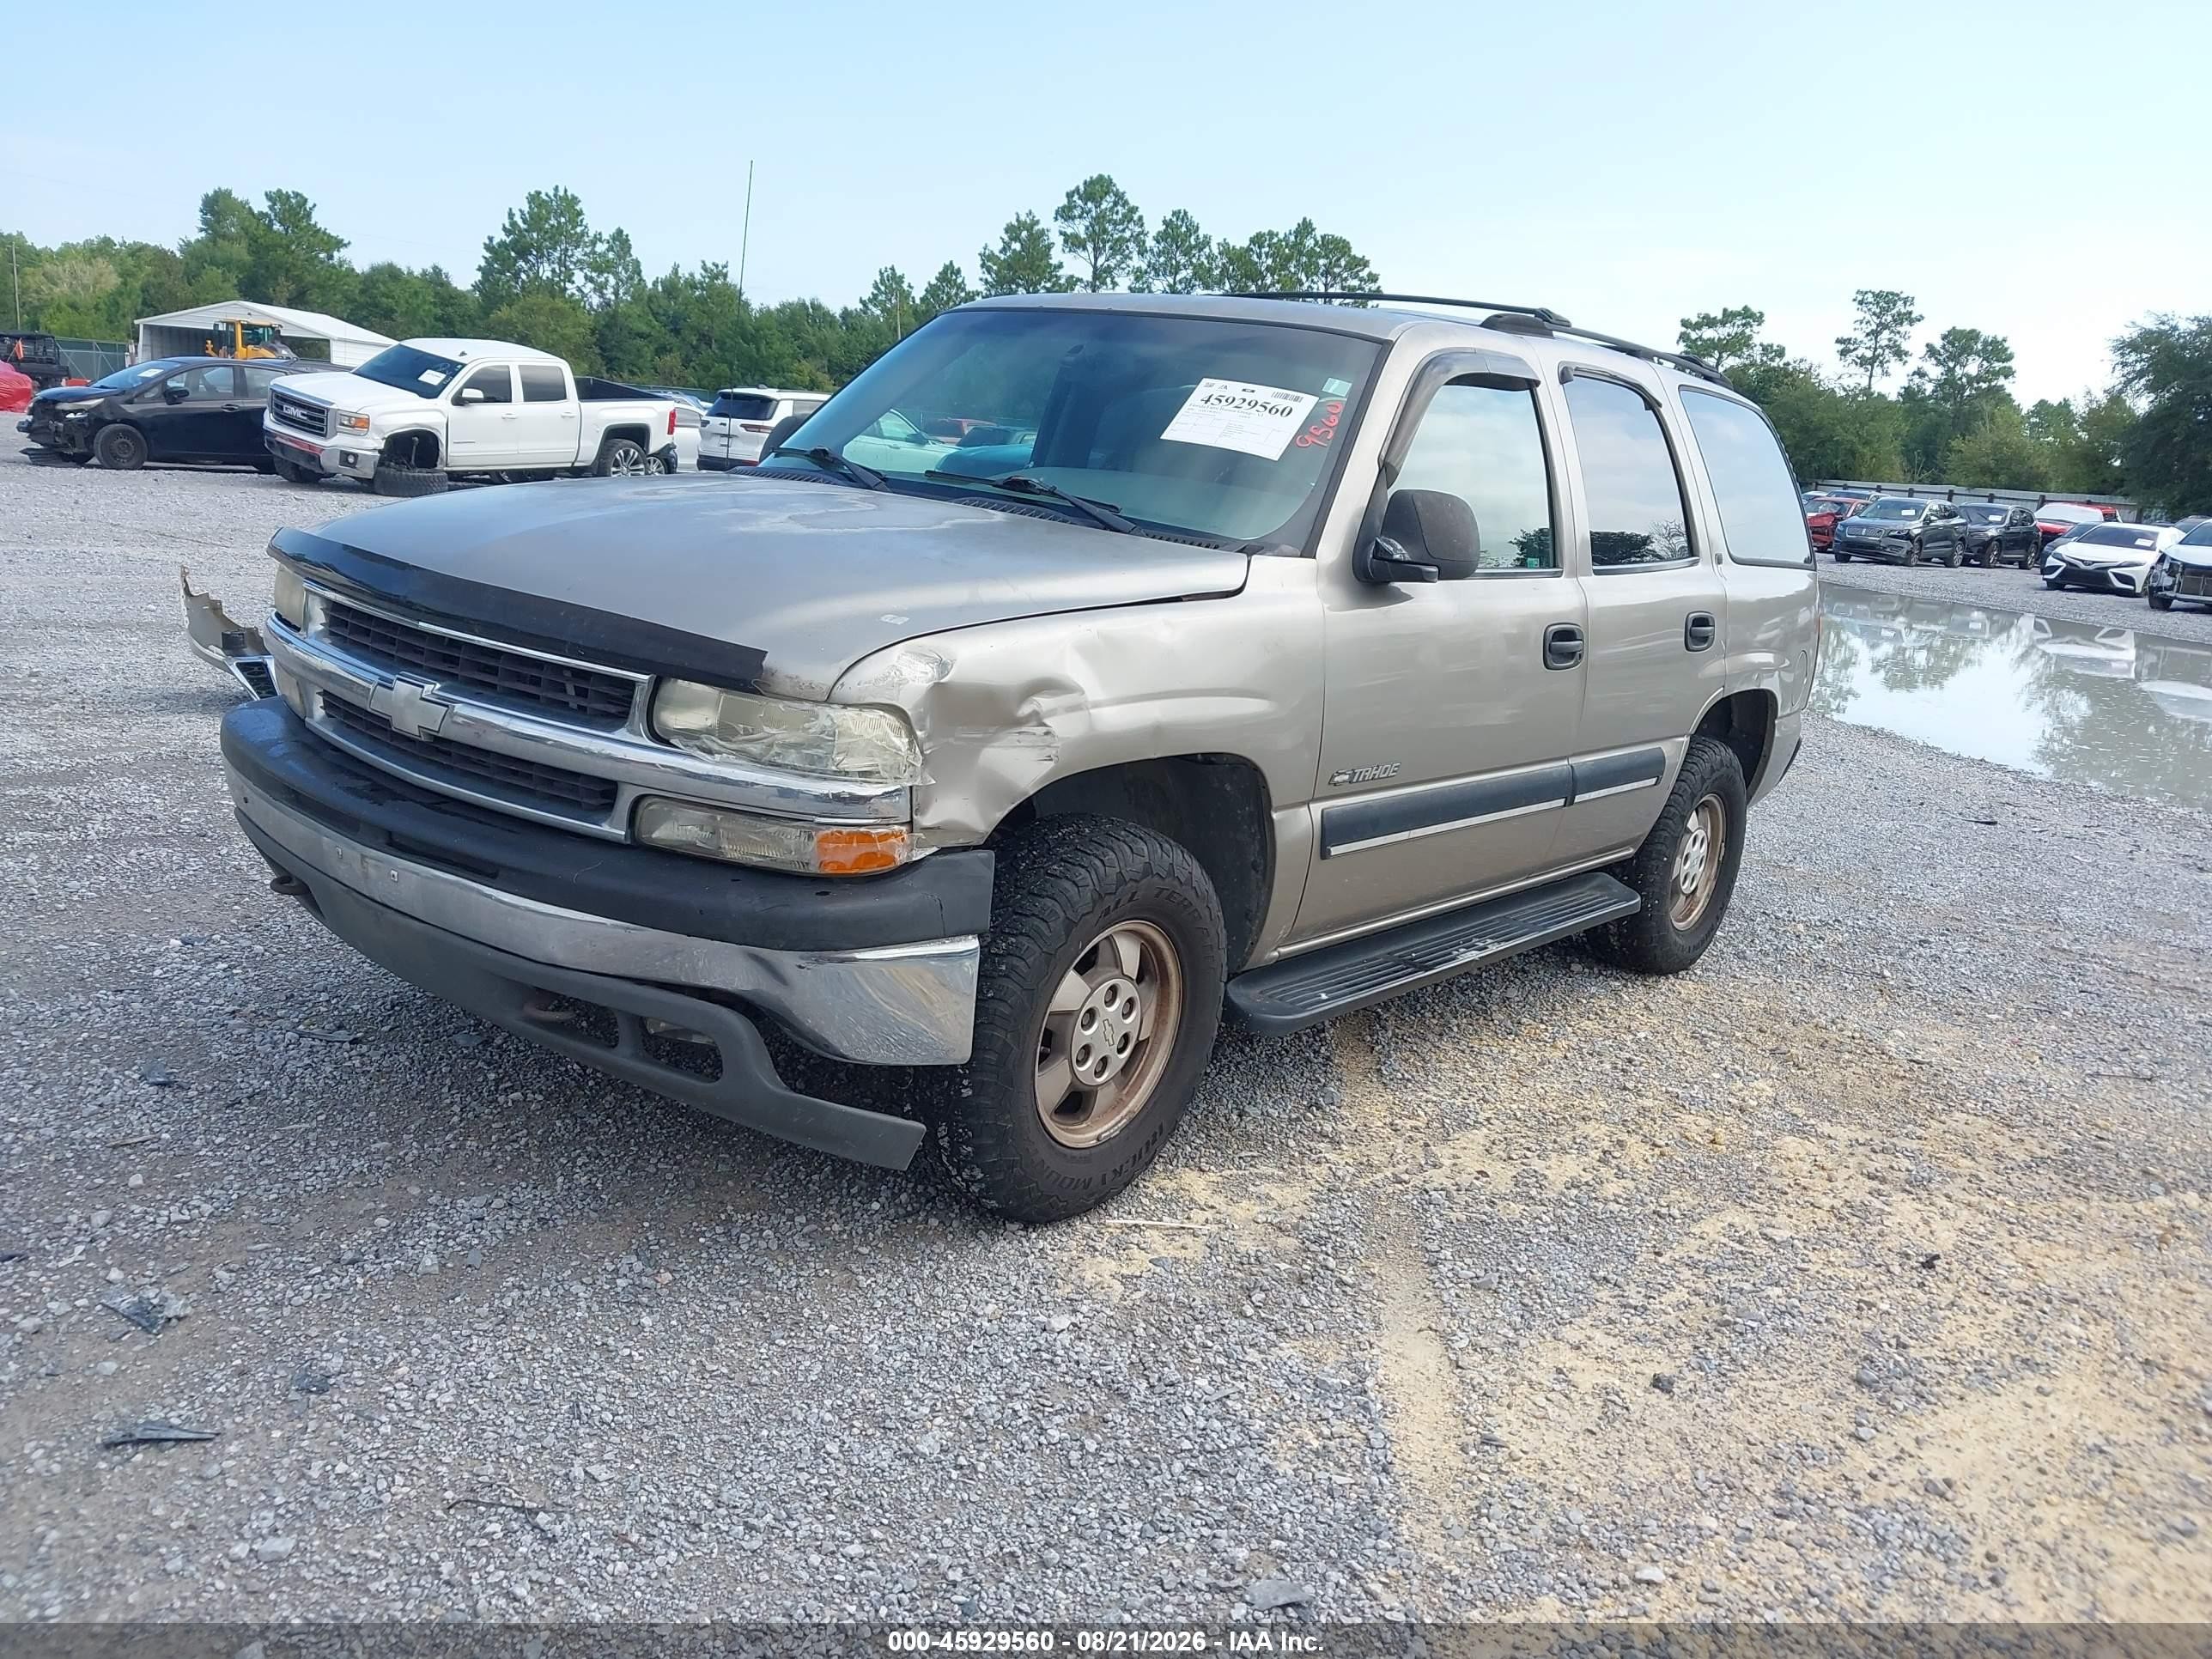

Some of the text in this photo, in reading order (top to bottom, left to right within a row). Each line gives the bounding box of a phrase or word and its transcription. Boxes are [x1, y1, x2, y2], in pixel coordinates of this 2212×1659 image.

[283, 404, 307, 420] GMC
[1200, 393, 1293, 418] 45929560
[1296, 401, 1343, 447] 9560
[1352, 763, 1401, 783] TAHOE
